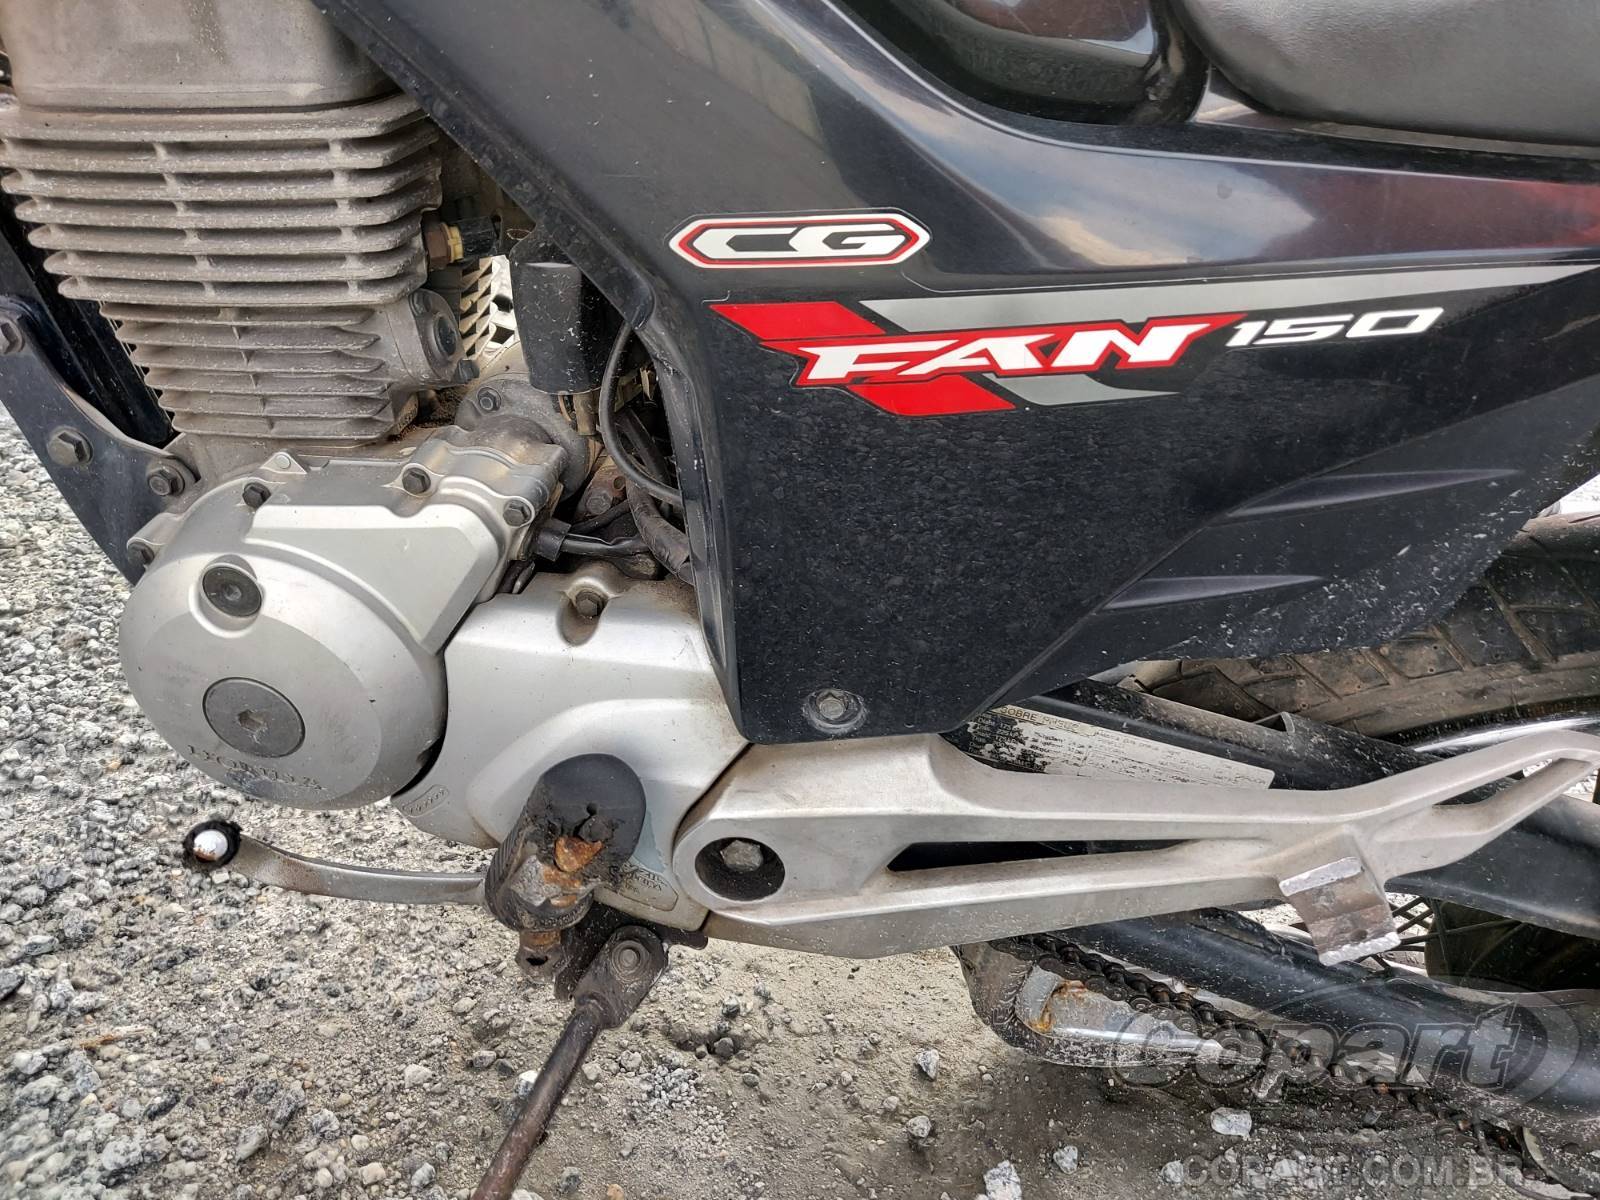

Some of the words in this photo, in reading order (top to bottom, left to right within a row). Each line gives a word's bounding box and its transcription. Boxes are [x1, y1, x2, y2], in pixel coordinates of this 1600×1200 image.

[690, 223, 908, 260] CG
[797, 321, 1214, 381] FAN
[1226, 306, 1444, 348] 150
